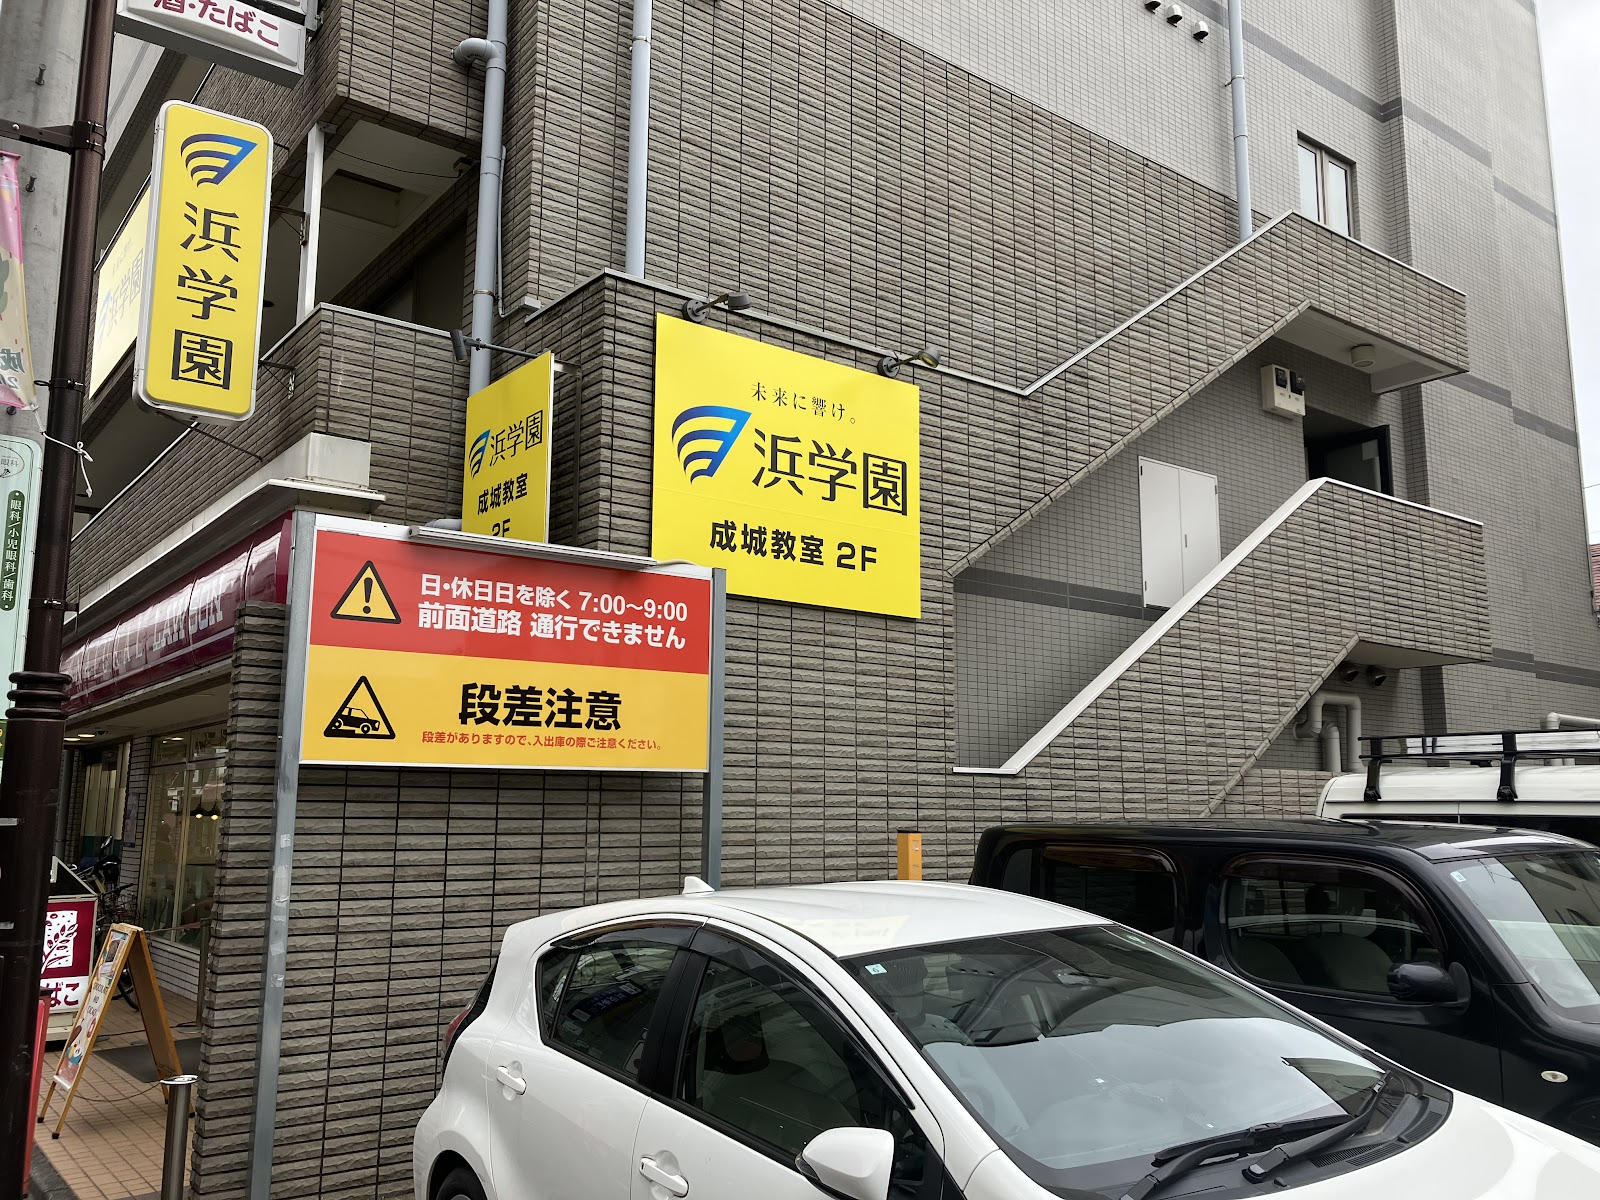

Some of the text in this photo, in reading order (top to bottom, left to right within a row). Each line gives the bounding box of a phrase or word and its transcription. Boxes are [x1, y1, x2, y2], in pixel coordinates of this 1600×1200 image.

[171, 201, 242, 390] 浜学園
[750, 382, 856, 424] 未来に響け。
[490, 409, 543, 467] 浜学園
[477, 472, 528, 515] 成城教室
[752, 428, 908, 516] 浜学園
[492, 518, 510, 537] 2F
[709, 520, 877, 572] 成城教室 2F
[418, 601, 686, 649] 前面道路 通行できません
[458, 682, 622, 731] 段差注意
[421, 731, 662, 750] 段差がありますので、入出庫の際ご注意ください。
